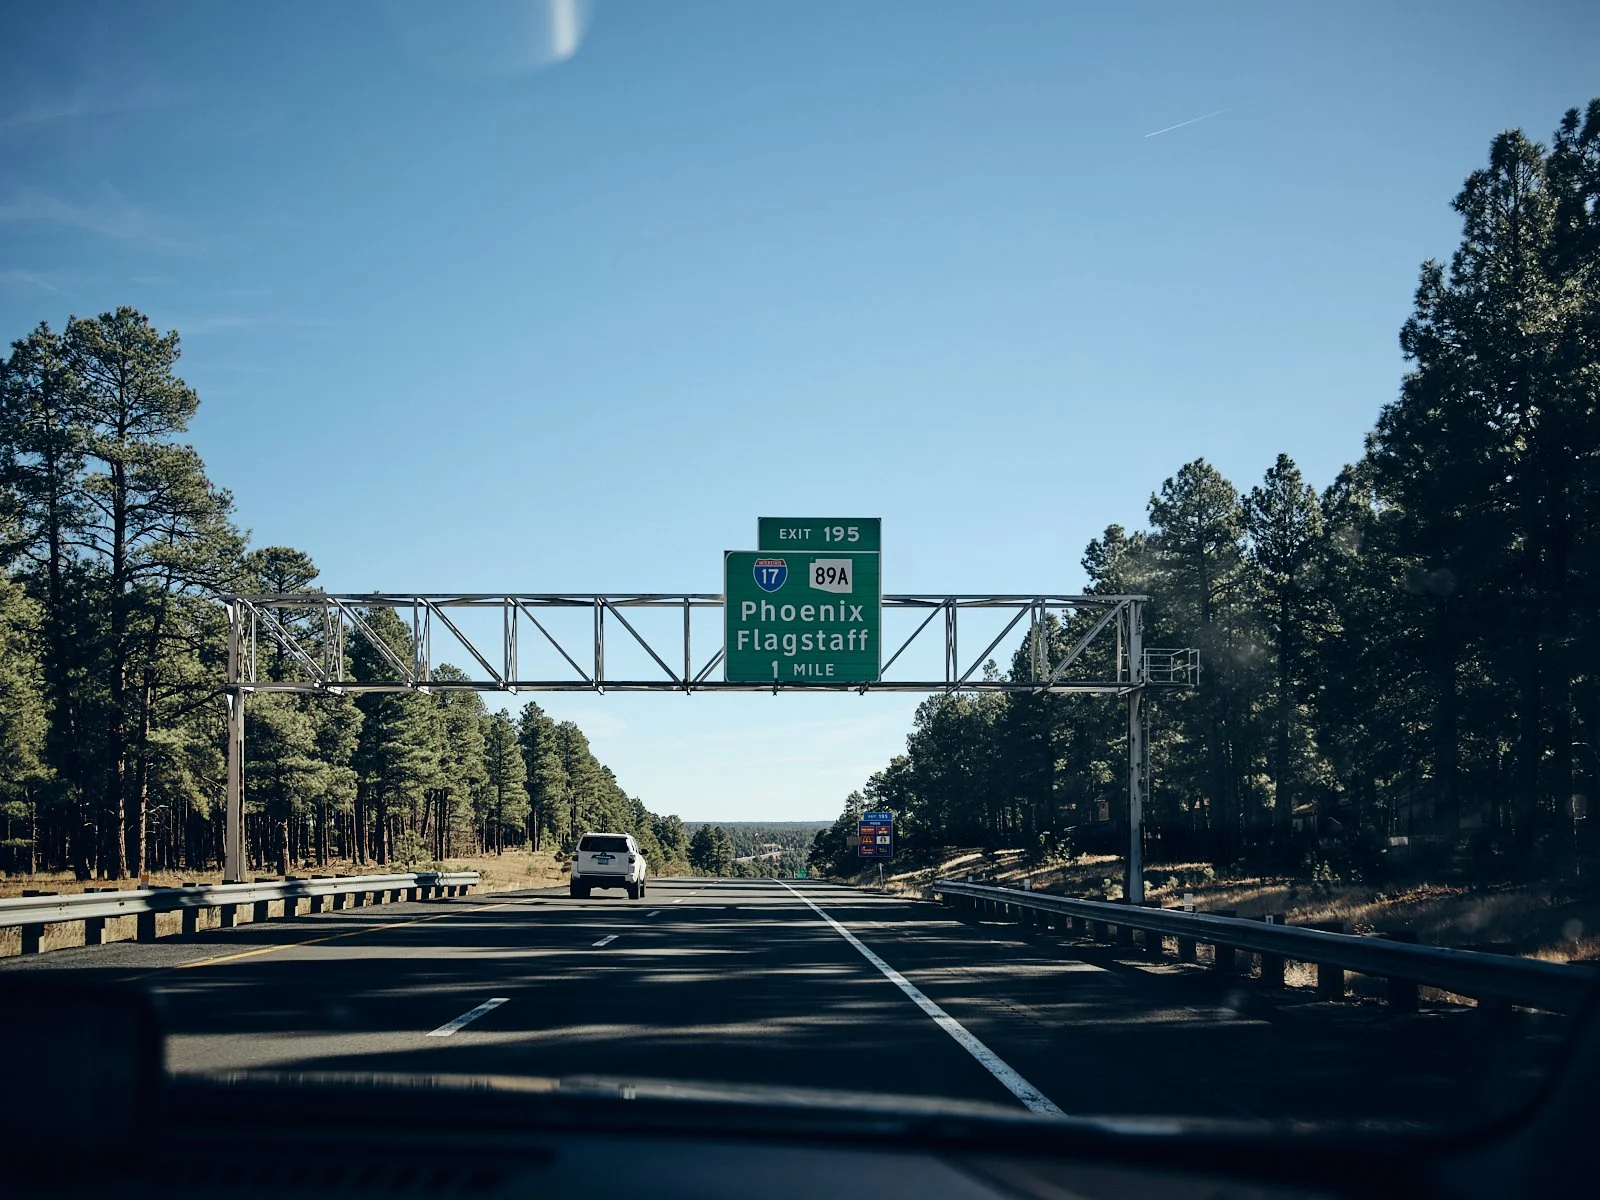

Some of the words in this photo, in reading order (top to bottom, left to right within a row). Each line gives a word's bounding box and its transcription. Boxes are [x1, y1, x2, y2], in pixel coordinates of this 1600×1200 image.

[779, 528, 812, 540] EXIT
[824, 526, 860, 542] 195
[761, 568, 779, 584] 17
[815, 566, 849, 585] 89A
[741, 599, 864, 622] Phoenix
[737, 628, 869, 657] Flagstaff
[771, 660, 779, 679] 1
[793, 663, 835, 676] MILE
